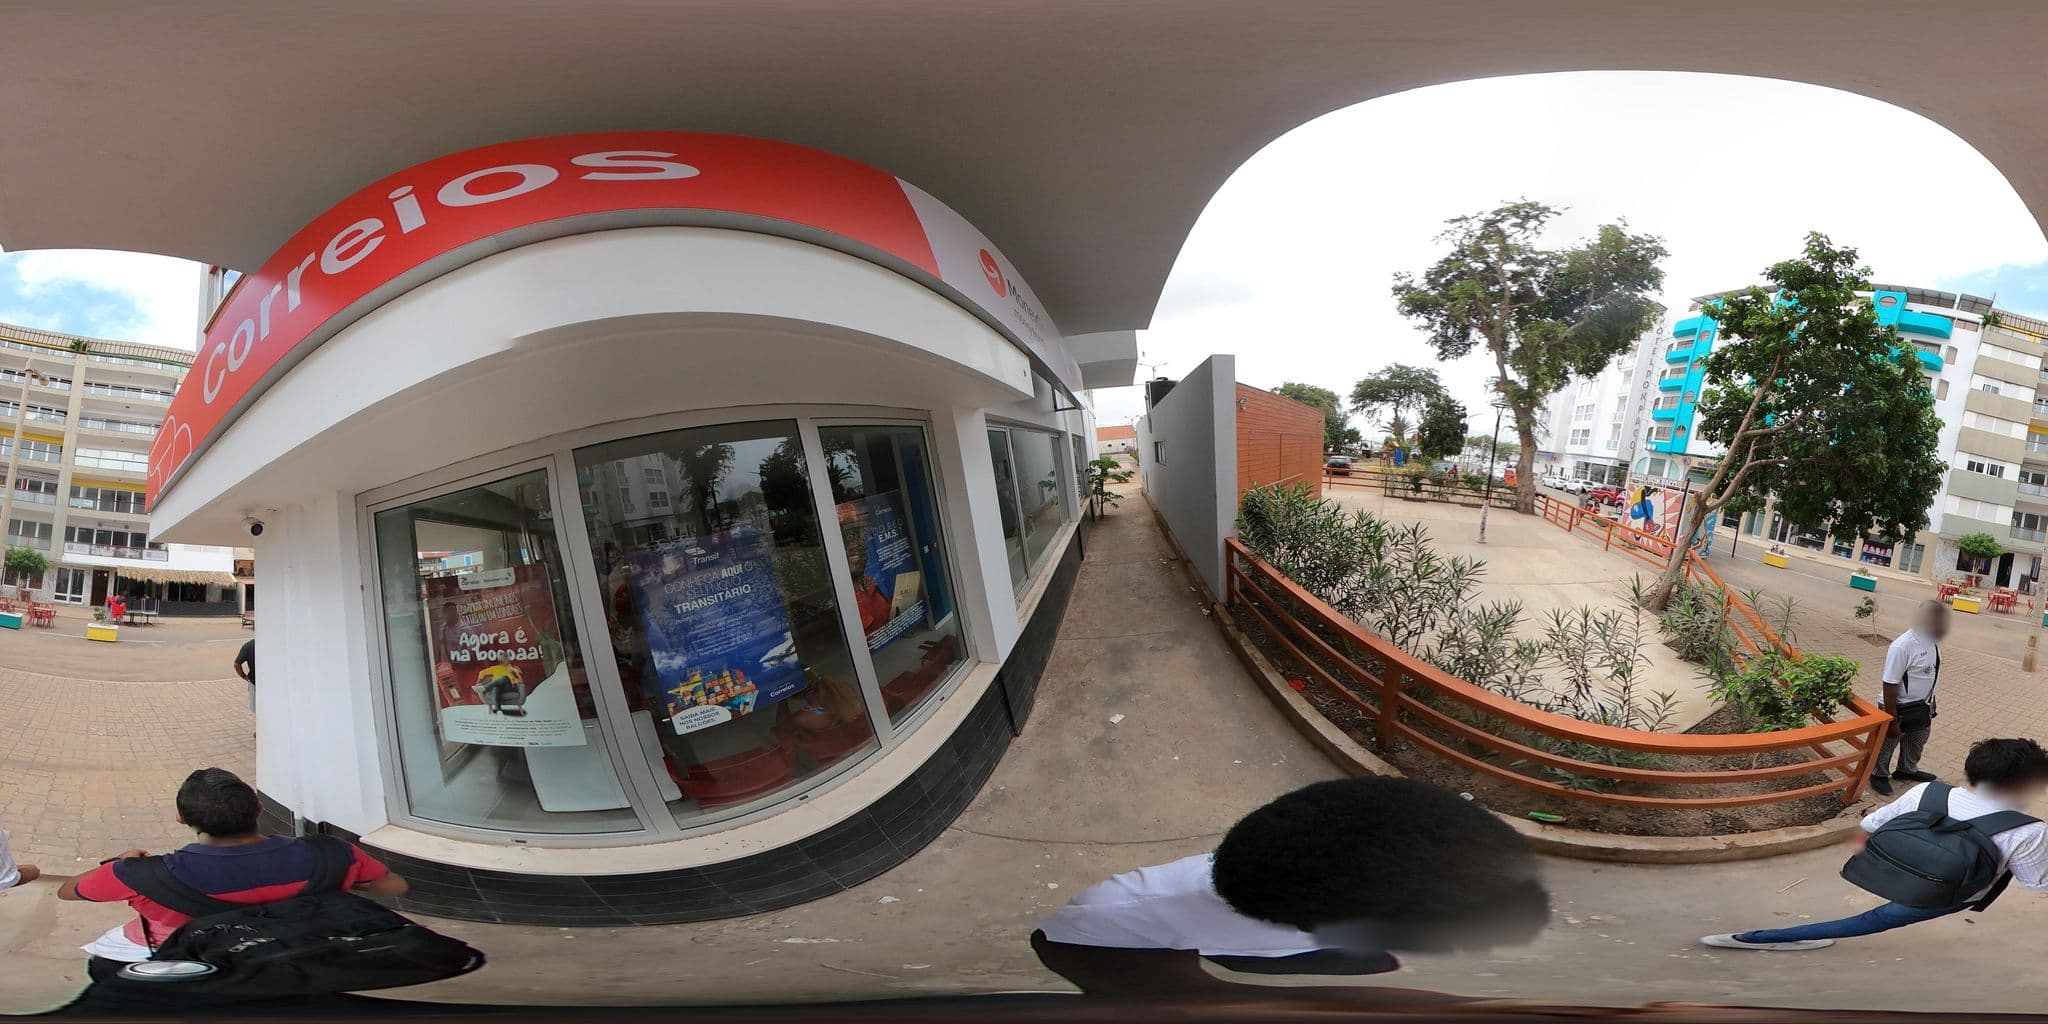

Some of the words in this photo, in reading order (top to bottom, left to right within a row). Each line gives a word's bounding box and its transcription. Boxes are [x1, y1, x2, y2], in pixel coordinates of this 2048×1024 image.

[203, 150, 701, 404] Correios
[693, 551, 721, 565] Transit
[721, 563, 743, 579] AQUI
[459, 631, 509, 650] Agora
[515, 627, 528, 644] é
[450, 649, 471, 662] na
